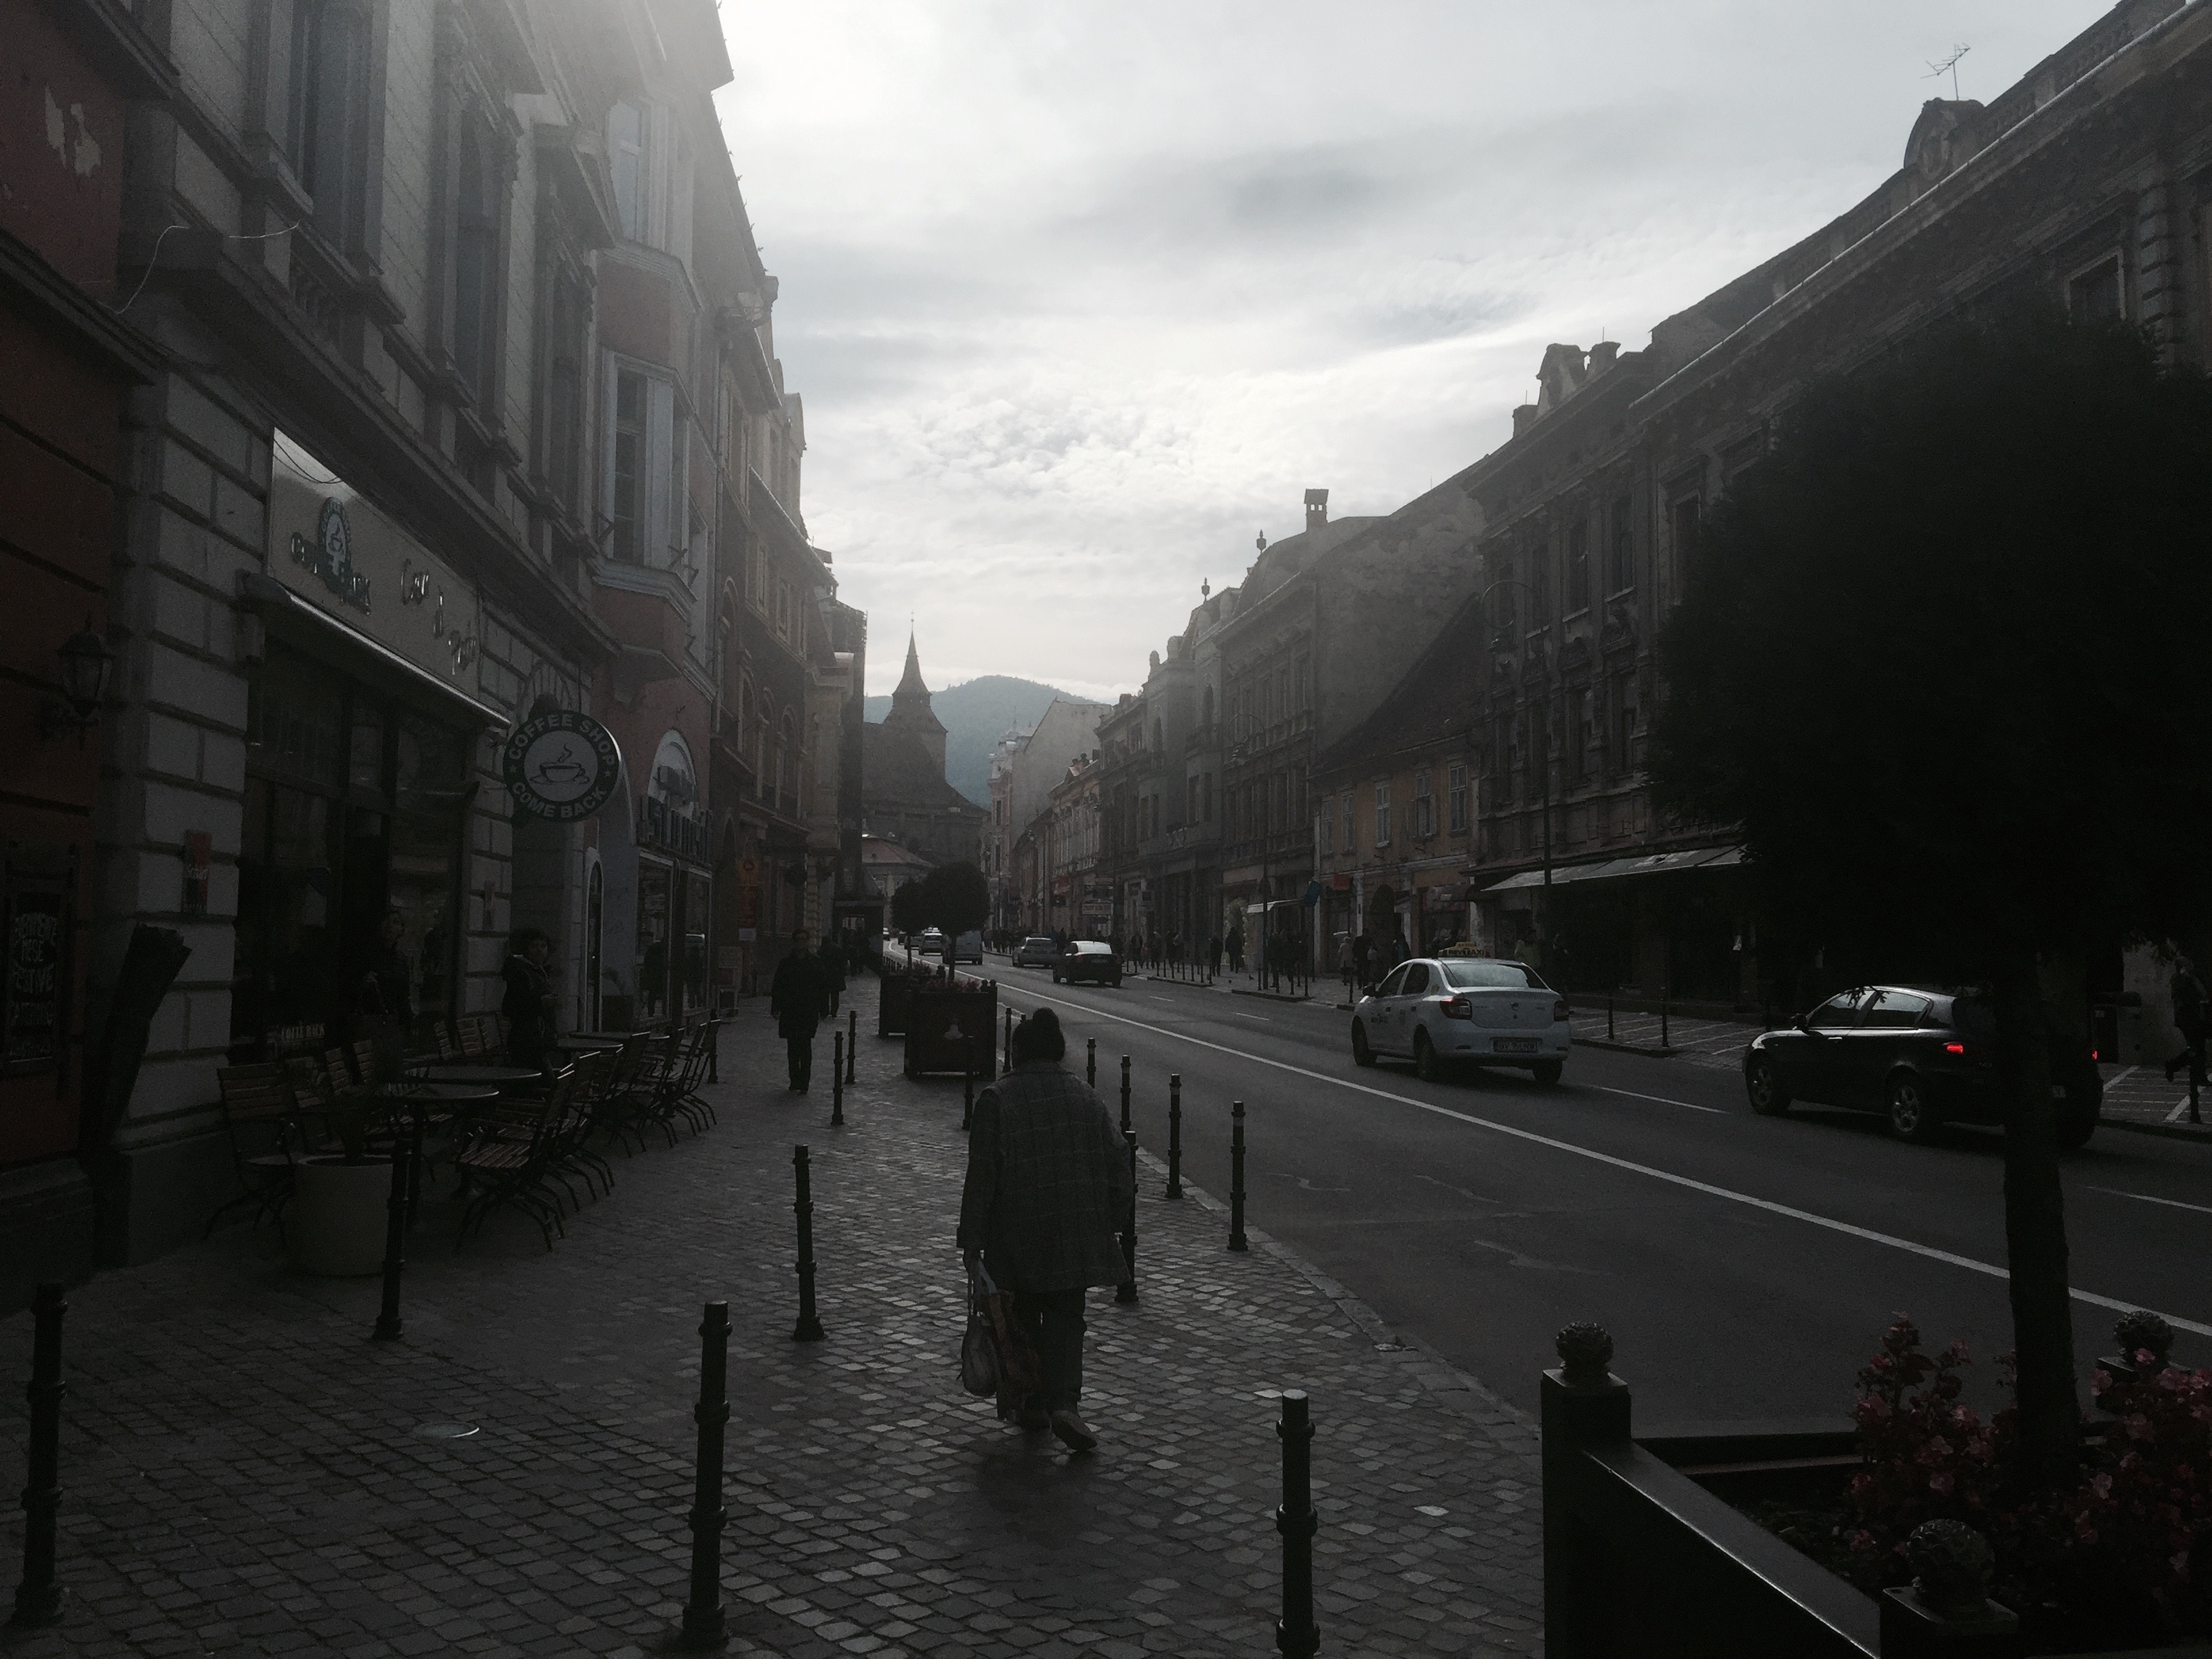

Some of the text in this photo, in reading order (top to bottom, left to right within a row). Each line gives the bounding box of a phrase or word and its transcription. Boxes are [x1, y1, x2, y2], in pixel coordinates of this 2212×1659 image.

[509, 713, 615, 766] COFFEE SHOP
[512, 781, 607, 818] COME BACK
